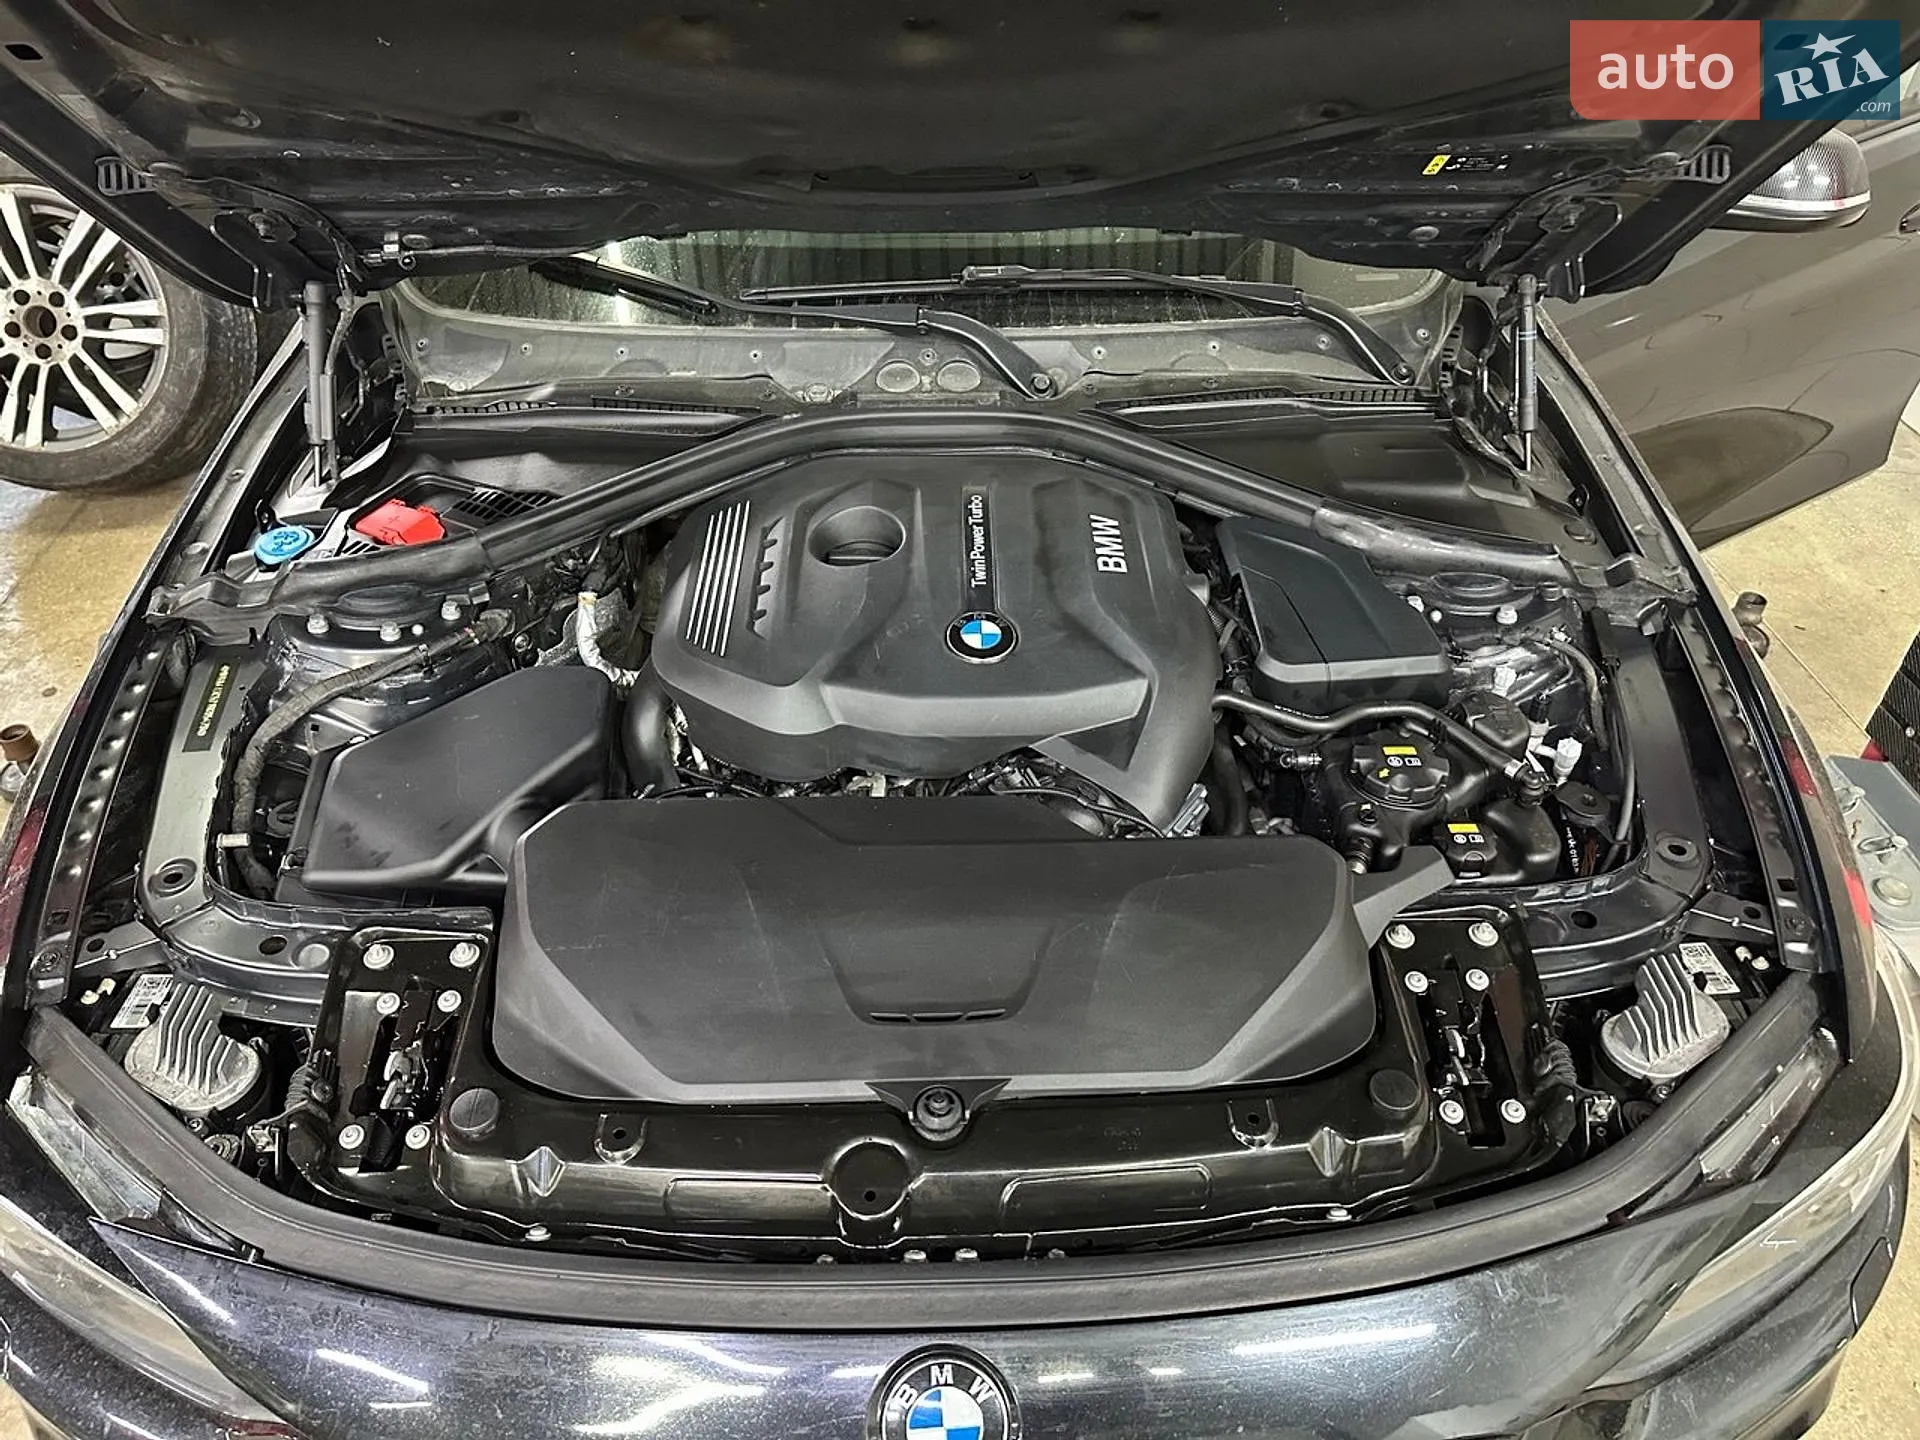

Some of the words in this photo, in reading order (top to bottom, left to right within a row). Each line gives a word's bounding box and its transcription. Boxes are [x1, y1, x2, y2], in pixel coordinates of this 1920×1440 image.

[967, 494, 985, 524] Turbo
[970, 525, 987, 588] TwinPower
[1089, 514, 1128, 573] BMW
[889, 1363, 997, 1410] BMW
